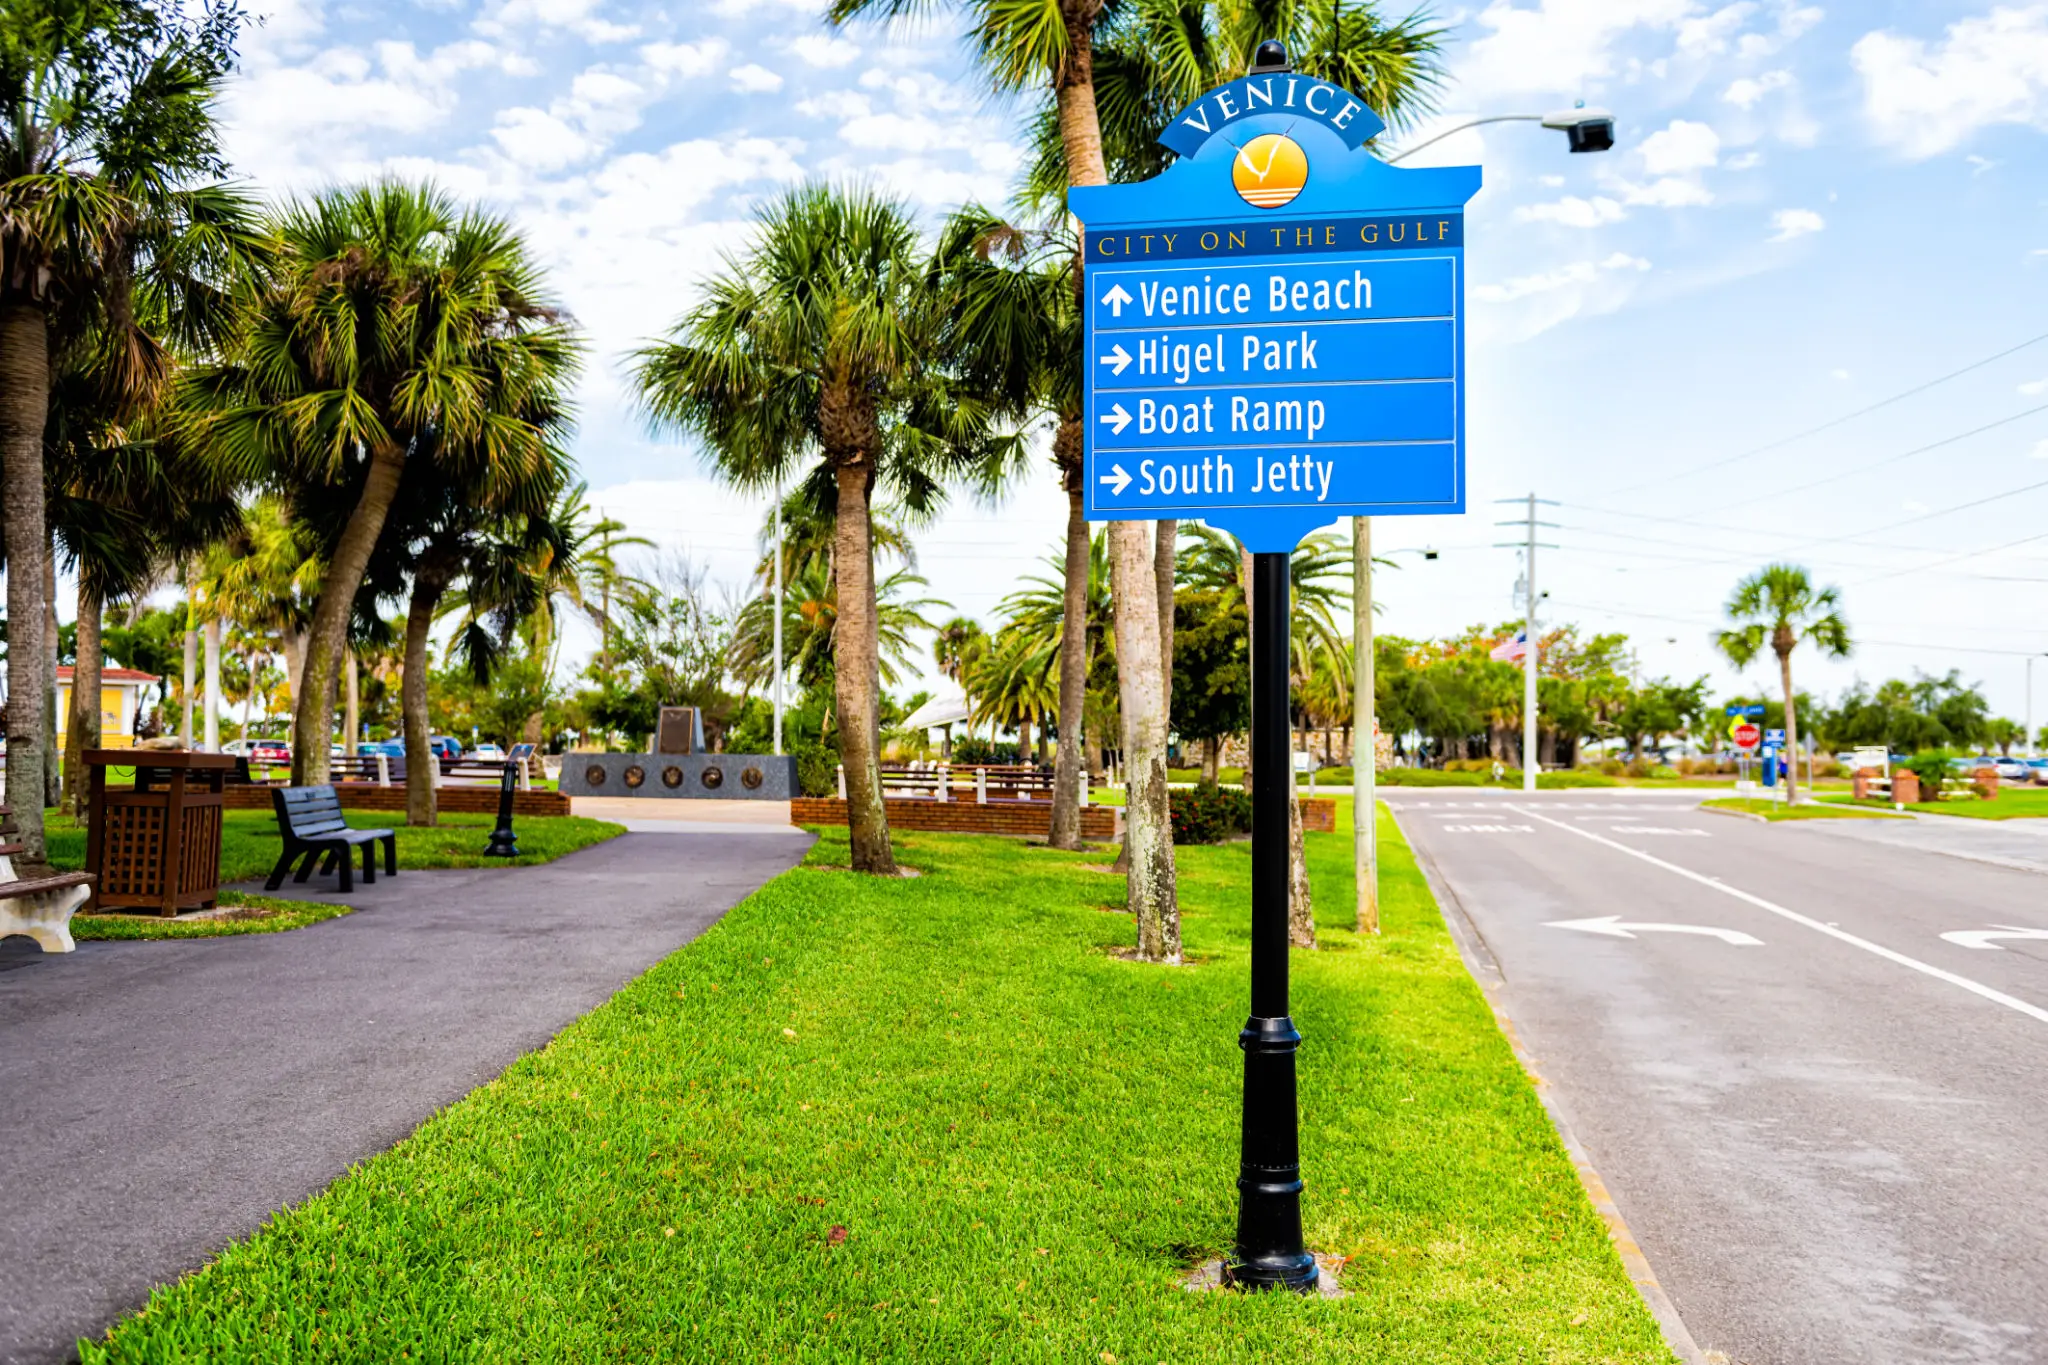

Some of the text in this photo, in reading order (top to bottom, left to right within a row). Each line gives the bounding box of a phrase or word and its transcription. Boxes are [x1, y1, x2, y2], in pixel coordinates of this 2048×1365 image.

[1183, 78, 1361, 134] VENICE
[1098, 221, 1450, 256] CITY ON THE GULF
[1140, 270, 1373, 317] Venice Beach
[1139, 331, 1318, 384] Higel Park
[1139, 396, 1326, 440] Boat Ramp
[1139, 454, 1334, 501] South Jetty
[1735, 730, 1759, 741] STOP
